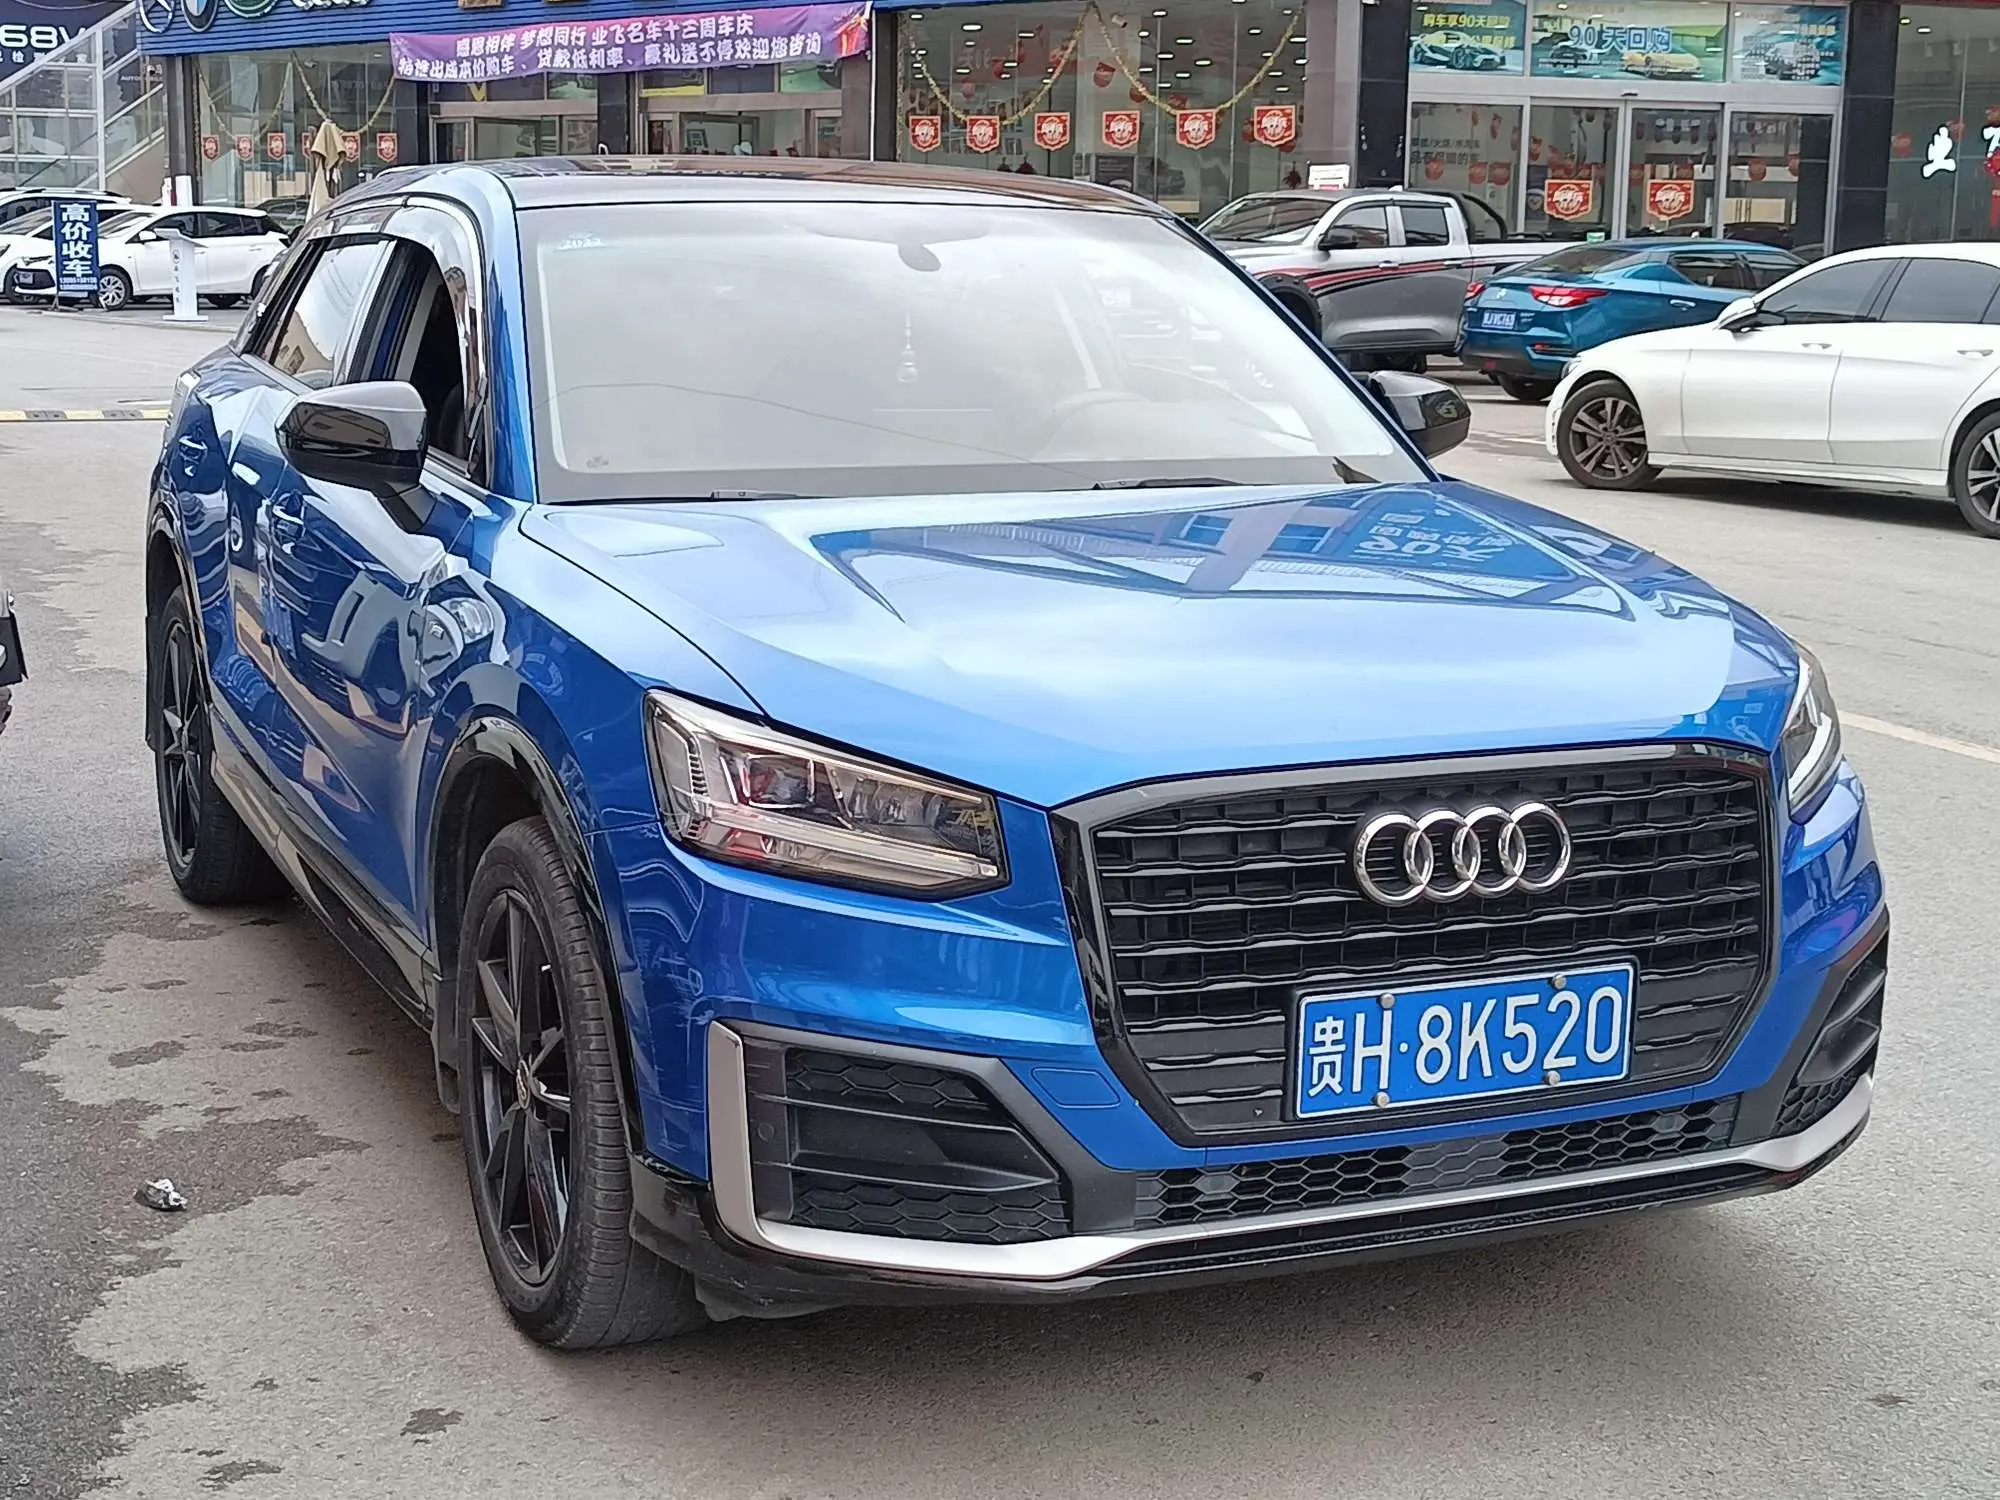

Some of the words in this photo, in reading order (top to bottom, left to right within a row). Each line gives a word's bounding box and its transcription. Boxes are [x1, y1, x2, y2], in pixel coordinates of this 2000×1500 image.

[520, 26, 586, 50] 梦想同行
[1568, 25, 1673, 53] 90天回购
[59, 203, 93, 278] 高价收车
[1308, 986, 1624, 1097] 贵H·8K520
